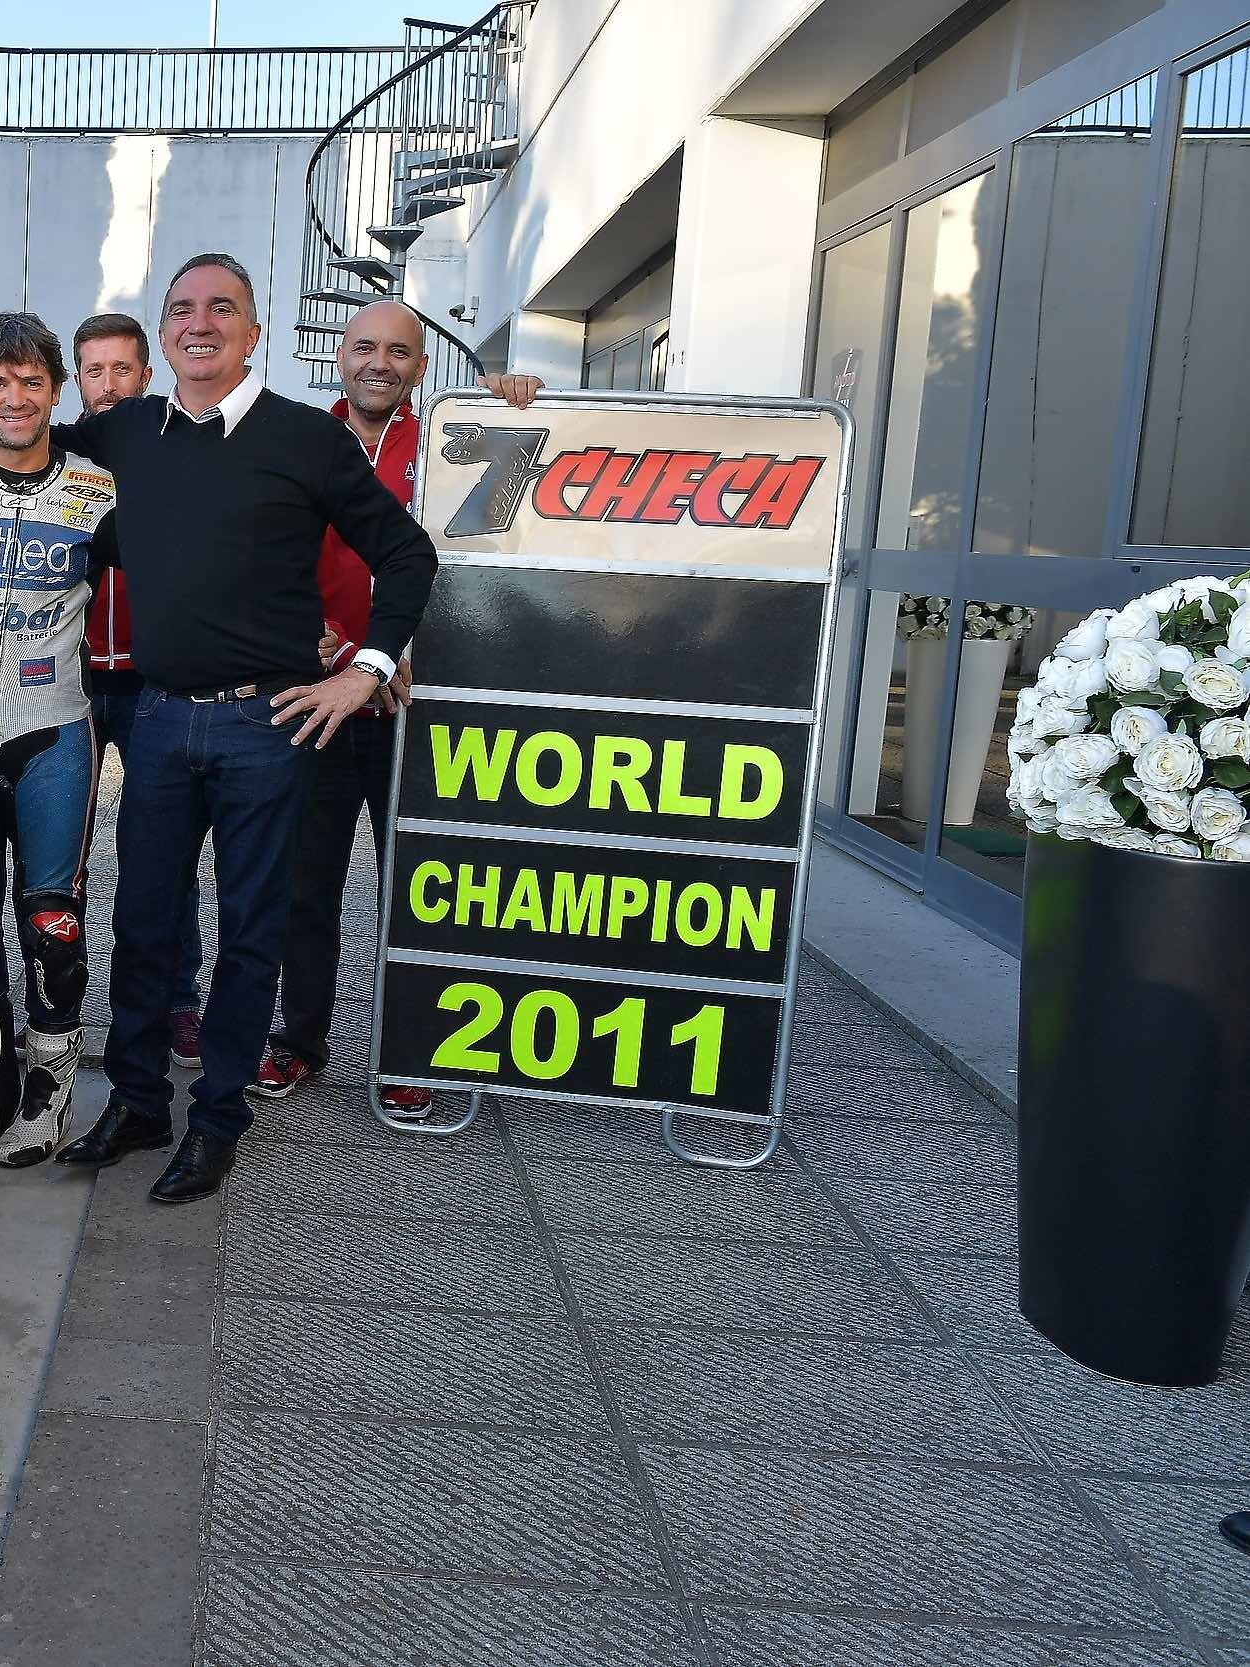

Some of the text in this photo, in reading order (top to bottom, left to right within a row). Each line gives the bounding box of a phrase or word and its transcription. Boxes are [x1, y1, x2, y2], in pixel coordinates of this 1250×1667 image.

[533, 446, 828, 530] CHECA
[429, 724, 784, 820] WORLD
[410, 860, 777, 952] CHAMPION
[430, 982, 726, 1096] 2011
